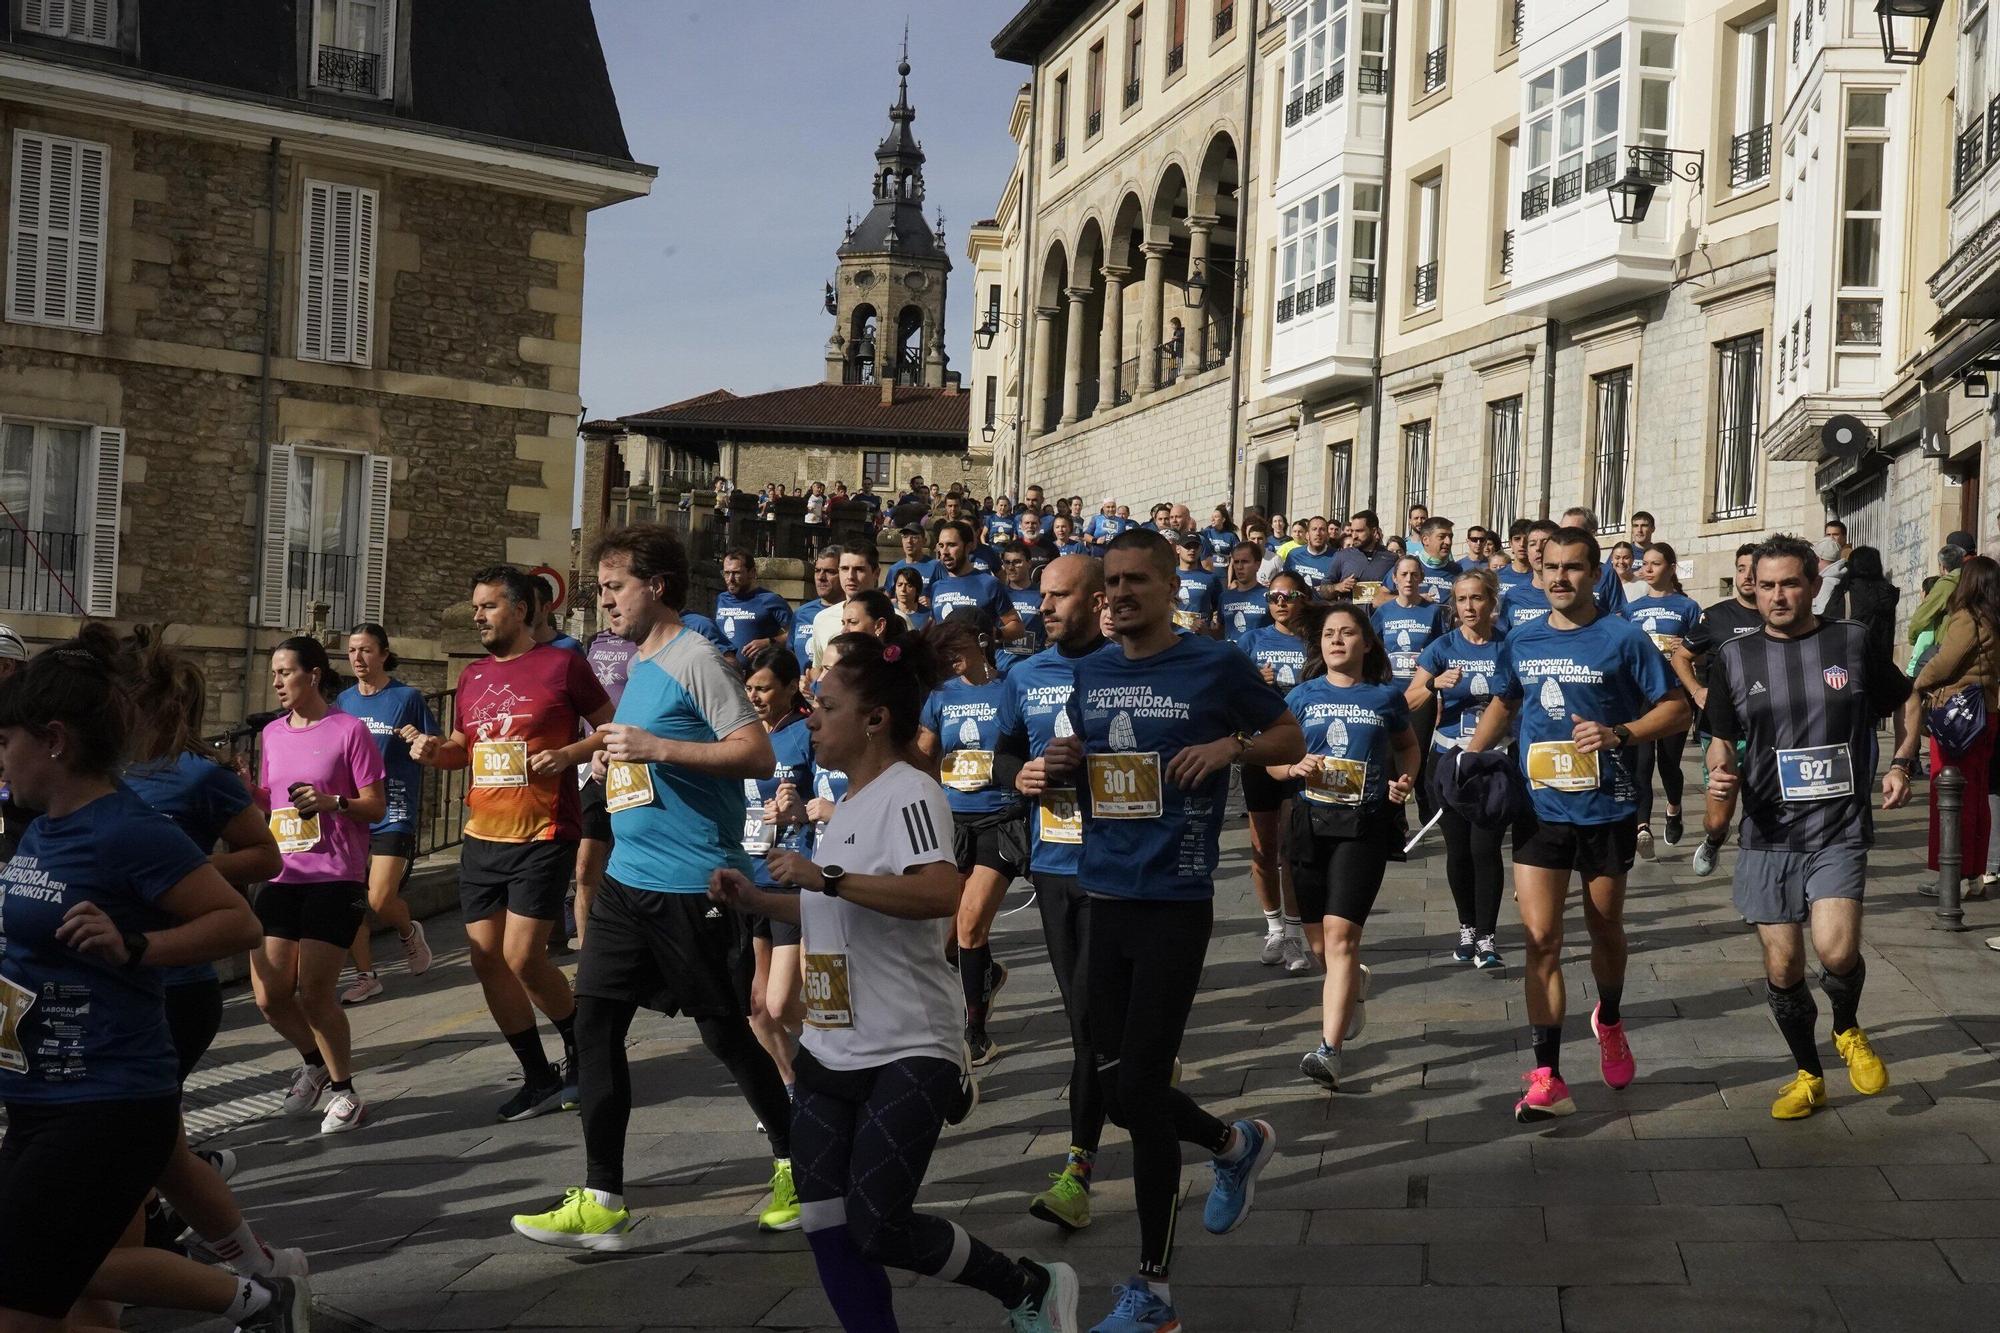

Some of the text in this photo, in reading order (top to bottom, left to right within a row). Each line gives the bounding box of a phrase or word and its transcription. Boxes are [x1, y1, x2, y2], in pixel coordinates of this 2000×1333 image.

[593, 653, 628, 661] MONCAYO
[1527, 659, 1574, 667] CONQUISTA
[1528, 665, 1590, 676] ALMENDRA
[1559, 675, 1603, 684] KONKISTA
[1088, 686, 1152, 698] LA CONQUISTA
[1096, 696, 1173, 709] ALMENDRA
[1174, 702, 1190, 710] REN
[1305, 705, 1314, 713] LA
[1133, 708, 1190, 720] KONKISTA
[1314, 709, 1376, 719] ALMENDRA
[1346, 717, 1384, 727] KONKISTA
[484, 753, 511, 771] 302
[952, 760, 978, 775] 233
[1552, 753, 1573, 772] 19
[1800, 759, 1832, 780] 927
[1104, 769, 1136, 794] 301
[1322, 770, 1348, 787] 138
[280, 818, 302, 836] 467
[47, 881, 67, 891] REN
[8, 883, 63, 904] KONKISTA
